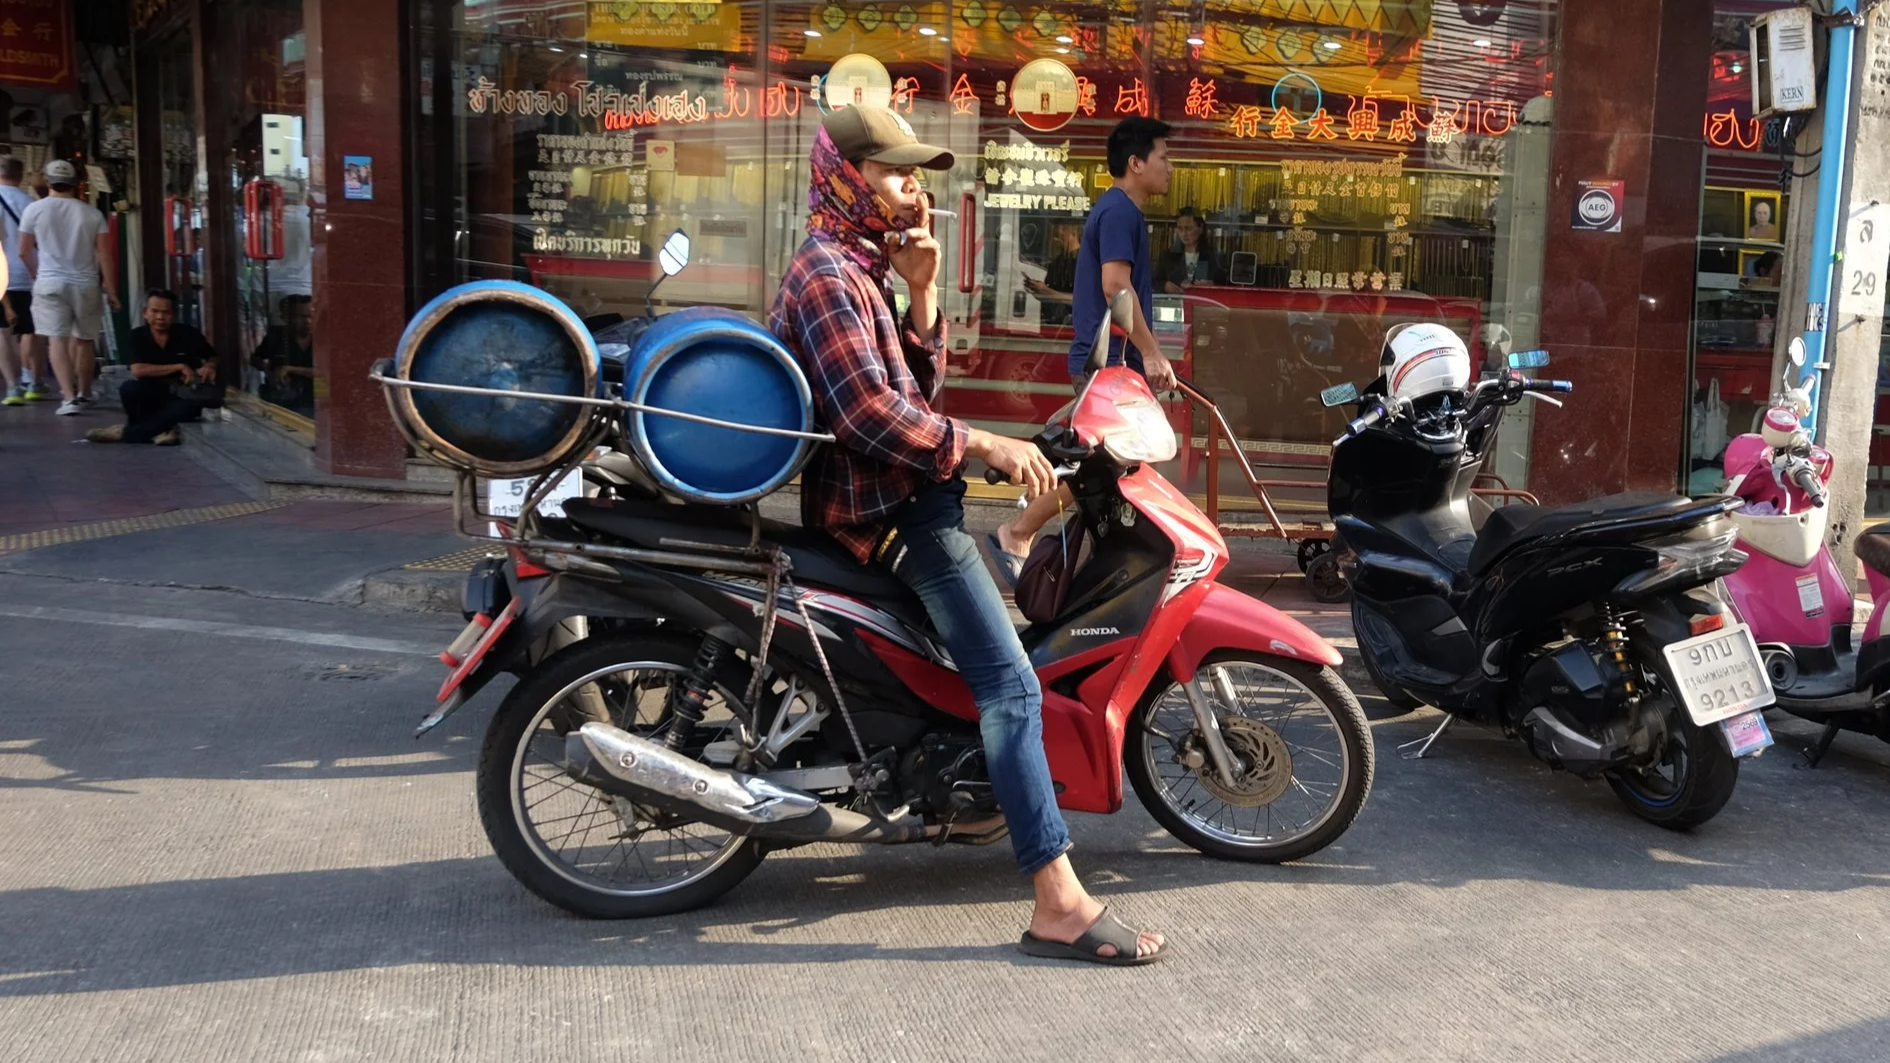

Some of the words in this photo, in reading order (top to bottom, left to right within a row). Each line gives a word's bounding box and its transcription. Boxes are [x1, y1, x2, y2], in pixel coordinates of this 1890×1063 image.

[467, 76, 567, 116] ห้างทอง
[1781, 86, 1804, 99] KERN
[984, 193, 1042, 209] JEWELRY
[1044, 195, 1091, 211] PLEASE
[1588, 203, 1606, 211] AEG
[1851, 269, 1876, 296] 29
[1070, 627, 1120, 636] HONDA
[1700, 681, 1754, 711] 9213
